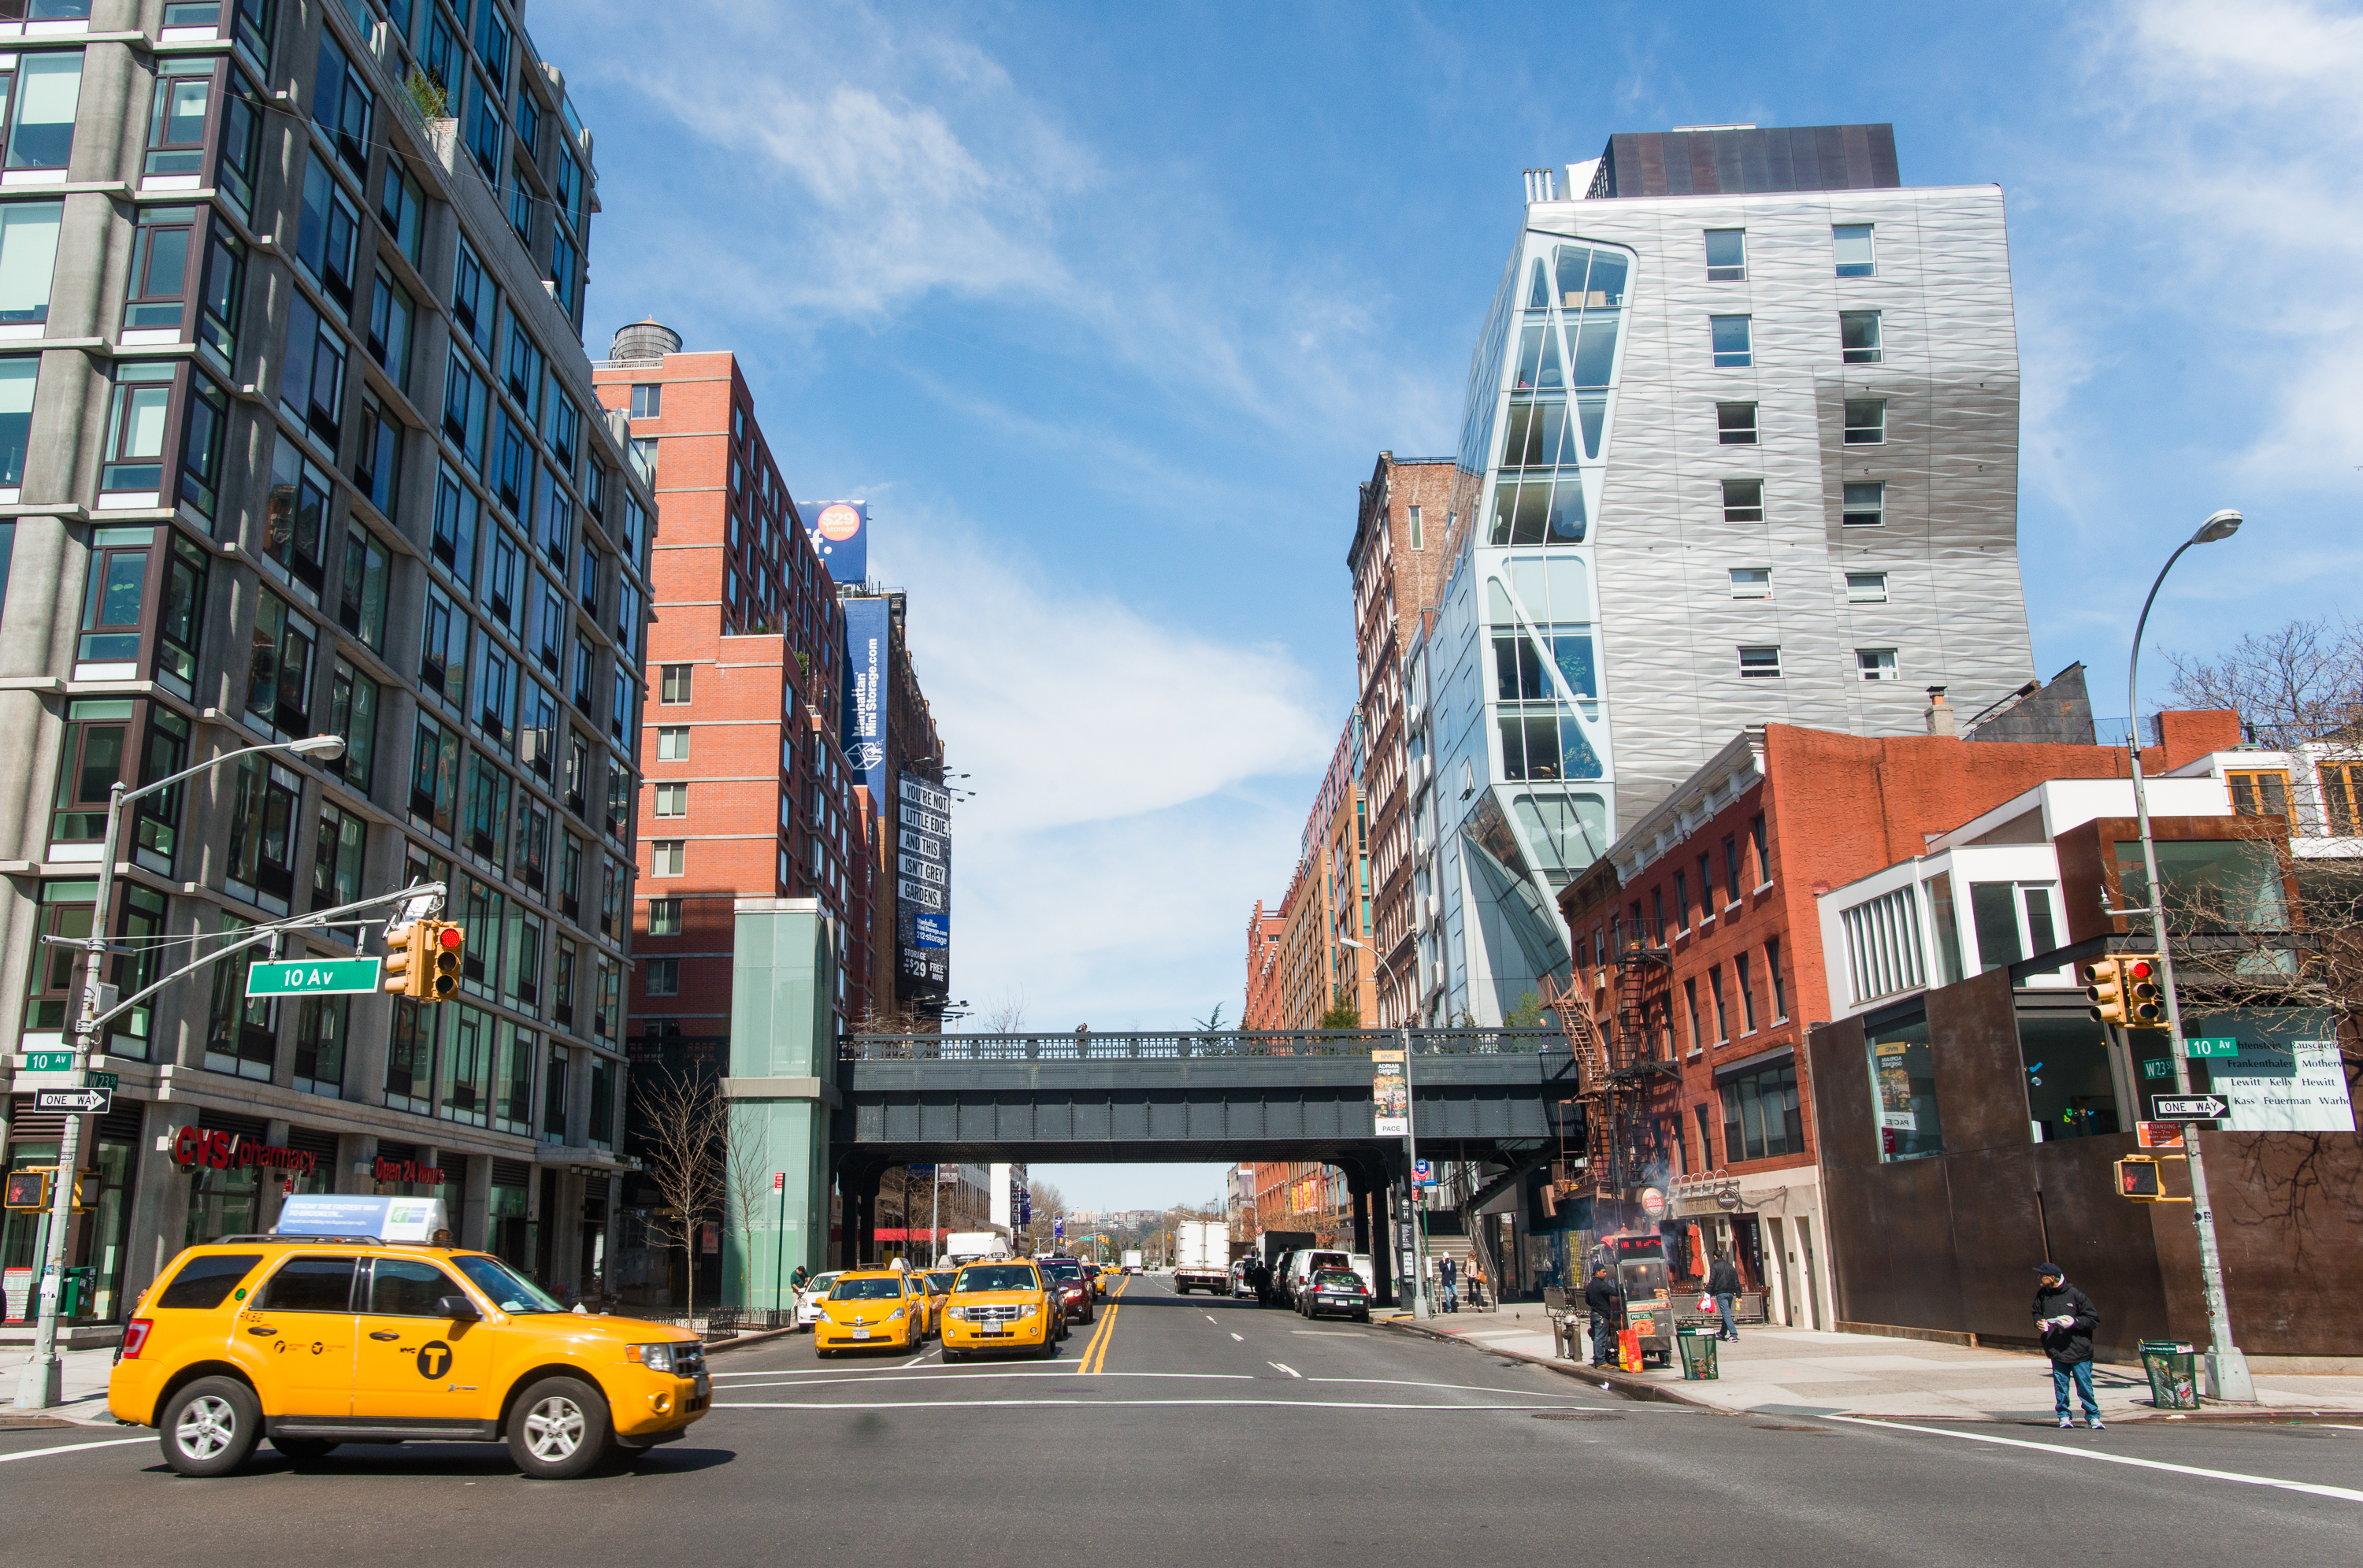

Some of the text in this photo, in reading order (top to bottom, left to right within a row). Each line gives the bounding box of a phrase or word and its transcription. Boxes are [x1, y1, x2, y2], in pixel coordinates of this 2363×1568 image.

[822, 512, 855, 527] $29
[866, 638, 879, 736] Mini Storage.com
[851, 673, 866, 736] Manhattan
[906, 783, 947, 811] YOU'RE NOT
[906, 808, 948, 837] LITTLE EDIE,
[906, 833, 937, 856] AND THIS
[905, 858, 944, 882] ISN'T GREY
[905, 883, 939, 906] GARDENS.
[917, 917, 937, 928] Manhattan
[917, 931, 948, 945] 212-storage
[926, 926, 948, 936] Storage.com
[904, 948, 926, 961] STORAGE
[910, 958, 944, 977] $29 FREE
[284, 969, 333, 986] 10 Av
[933, 973, 944, 982] MOVE
[2194, 1040, 2230, 1055] 10 Av
[33, 1055, 47, 1069] 10
[2146, 1060, 2172, 1077] W 23 St
[2228, 1059, 2292, 1068] Frankenthaler
[89, 1074, 117, 1088] W 23 St
[2270, 1077, 2293, 1088] Kelly
[2302, 1077, 2335, 1086] Hewitt
[46, 1095, 98, 1105] ONE WAY
[2165, 1103, 2217, 1111] ONE WAY
[376, 1156, 444, 1185] Open 24 Hours
[1696, 1199, 1707, 1211] HALF
[1708, 1199, 1721, 1210] KIN
[425, 1348, 447, 1375] T
